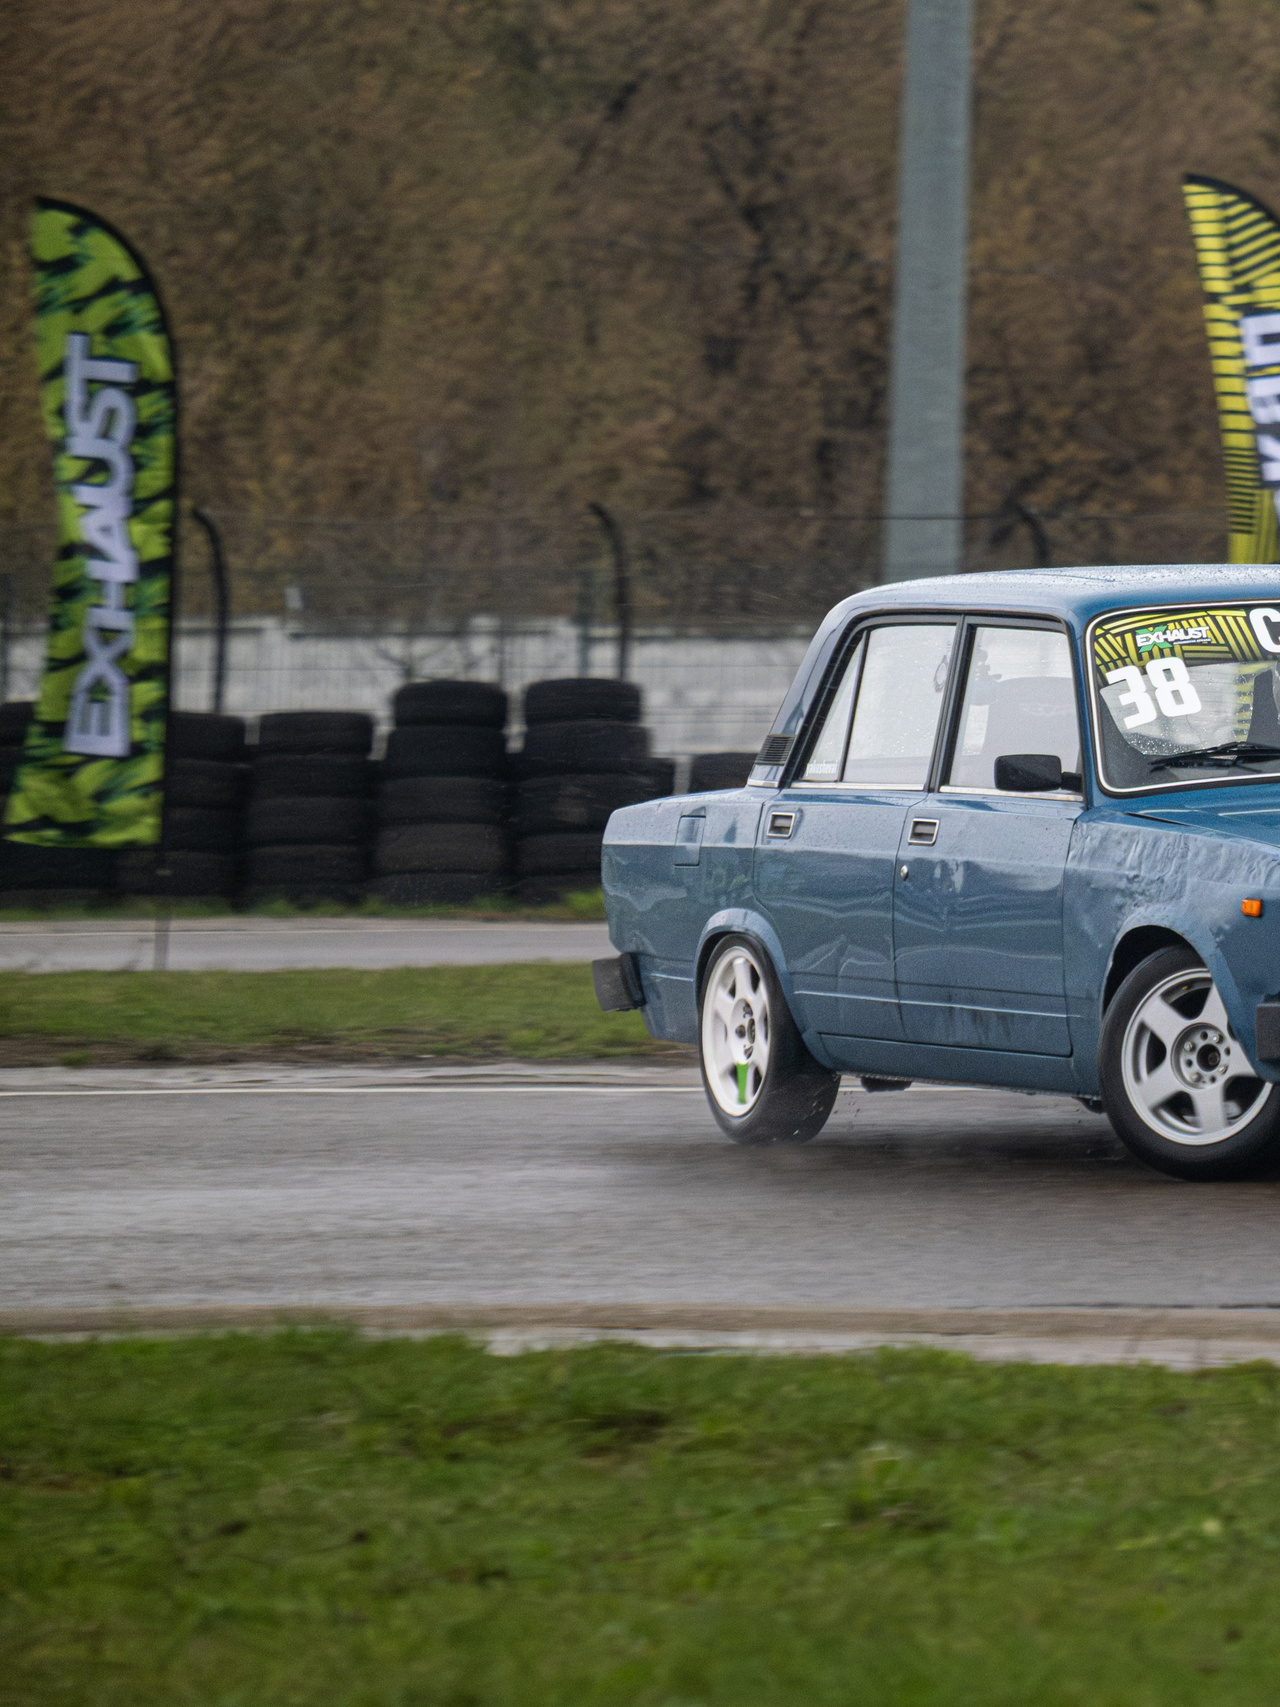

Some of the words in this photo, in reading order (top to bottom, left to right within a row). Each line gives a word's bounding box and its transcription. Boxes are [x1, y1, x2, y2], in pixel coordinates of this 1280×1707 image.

[64, 332, 139, 758] EXHAUST
[1135, 626, 1210, 648] EXHAUST
[1105, 656, 1203, 730] 38
